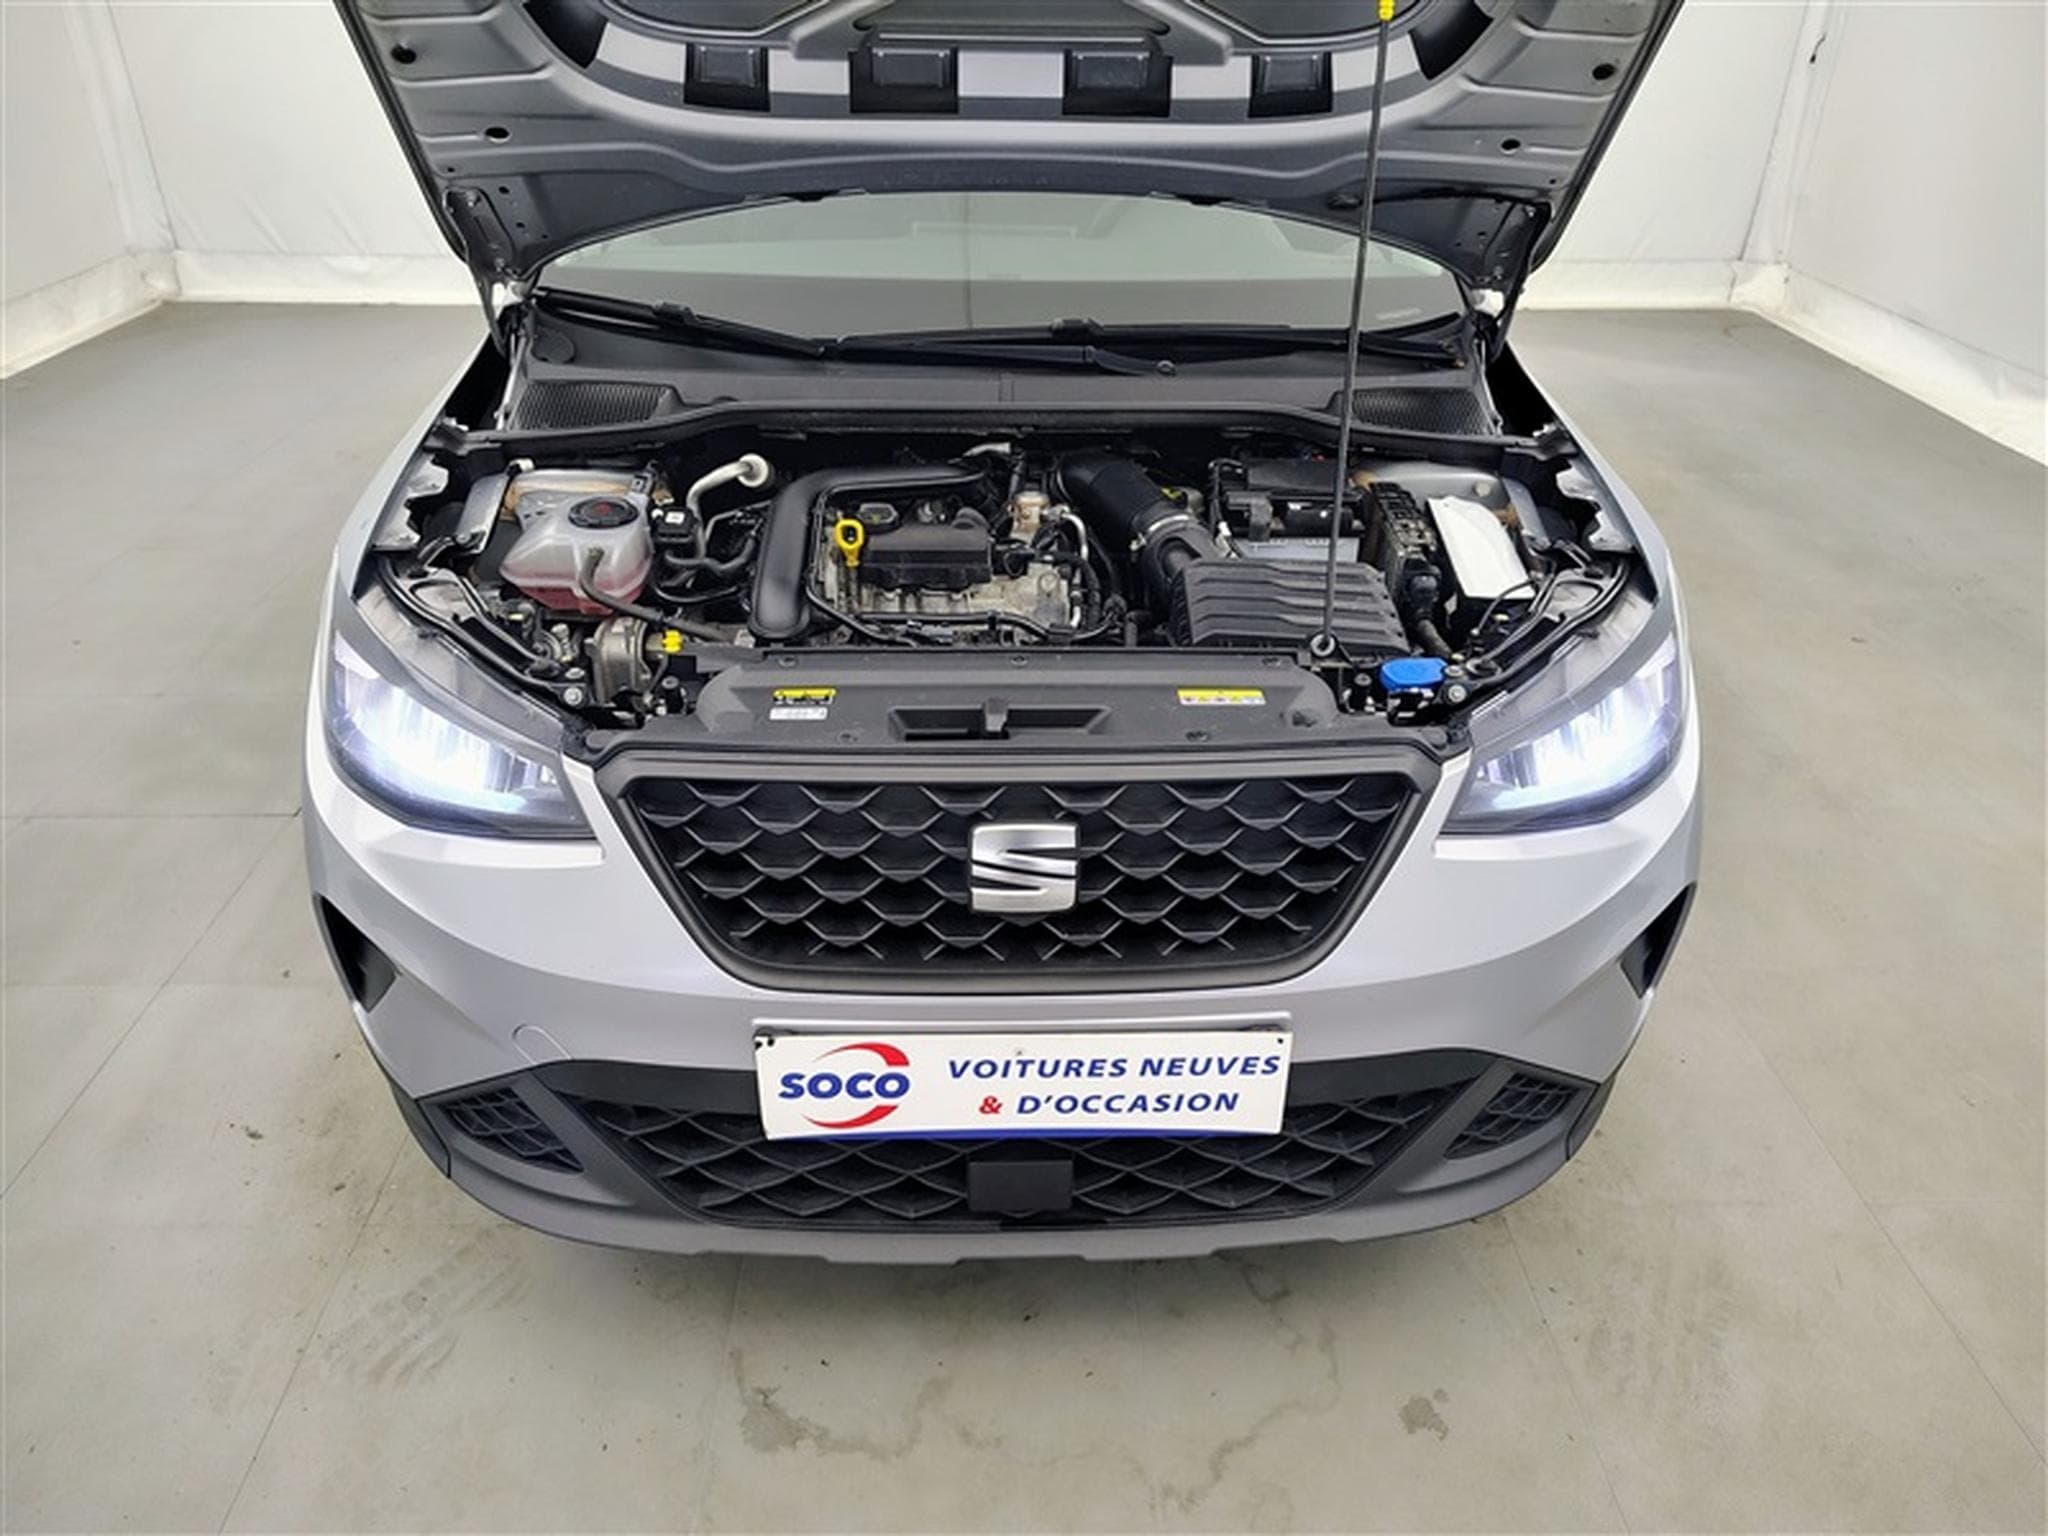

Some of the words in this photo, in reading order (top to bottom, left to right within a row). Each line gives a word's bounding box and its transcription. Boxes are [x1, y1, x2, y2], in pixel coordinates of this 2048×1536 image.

[949, 1058, 1128, 1080] VOITURES
[1138, 1055, 1281, 1078] NEUVES
[778, 1072, 910, 1100] SOCO
[979, 1096, 1003, 1116] &
[1016, 1092, 1239, 1116] D'OCCASION
